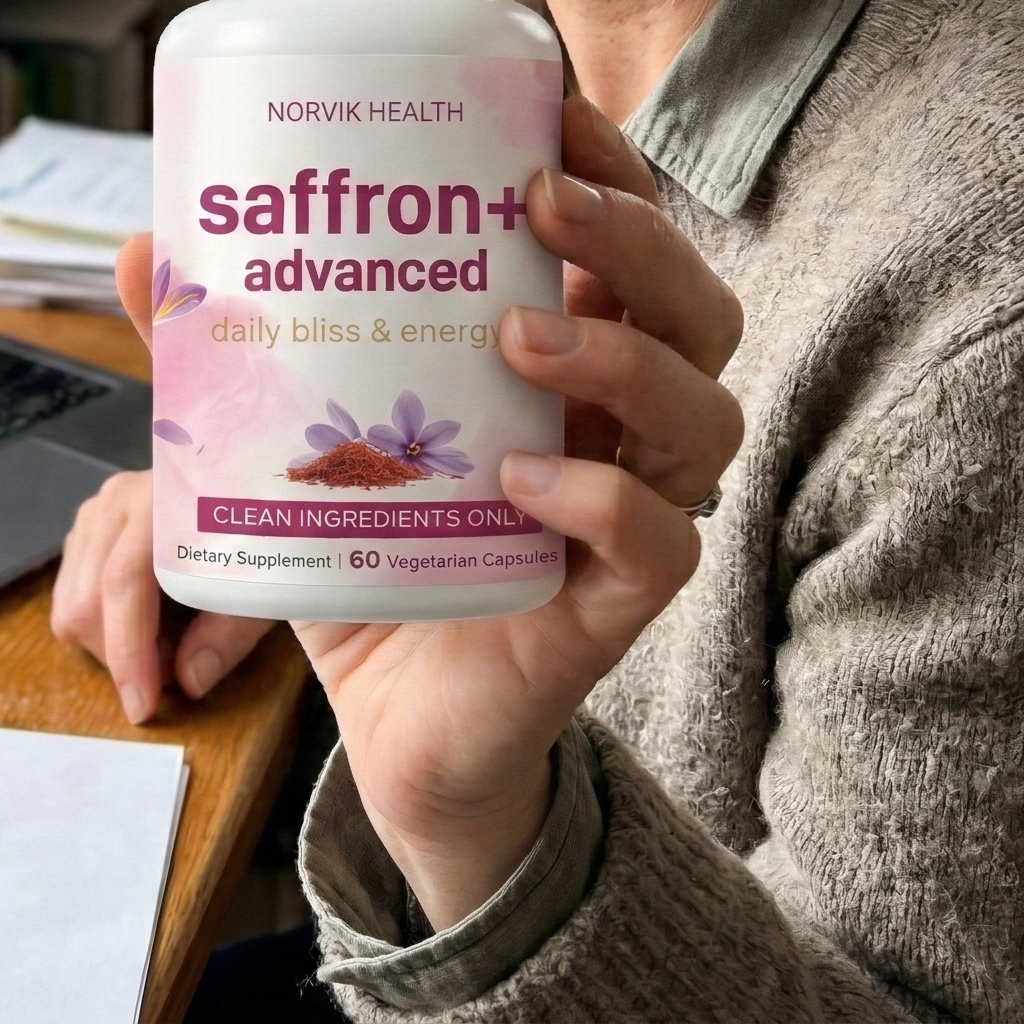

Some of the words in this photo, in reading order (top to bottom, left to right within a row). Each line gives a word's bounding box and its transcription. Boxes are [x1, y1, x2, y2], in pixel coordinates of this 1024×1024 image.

[268, 101, 362, 123] NORVIK
[369, 101, 464, 123] HEALTH
[198, 167, 527, 236] saffron+
[243, 248, 489, 293] advanced
[210, 315, 281, 350] daily
[292, 315, 361, 343] bliss
[370, 318, 392, 343] &
[212, 505, 292, 528] CLEAN
[299, 509, 461, 528] INGREDIENTS
[467, 507, 525, 527] ONLY
[177, 544, 233, 568] Dietary
[236, 550, 333, 571] Supplement
[349, 549, 381, 570] 60
[386, 552, 478, 573] Vegetarian
[482, 549, 559, 570] Capsules
